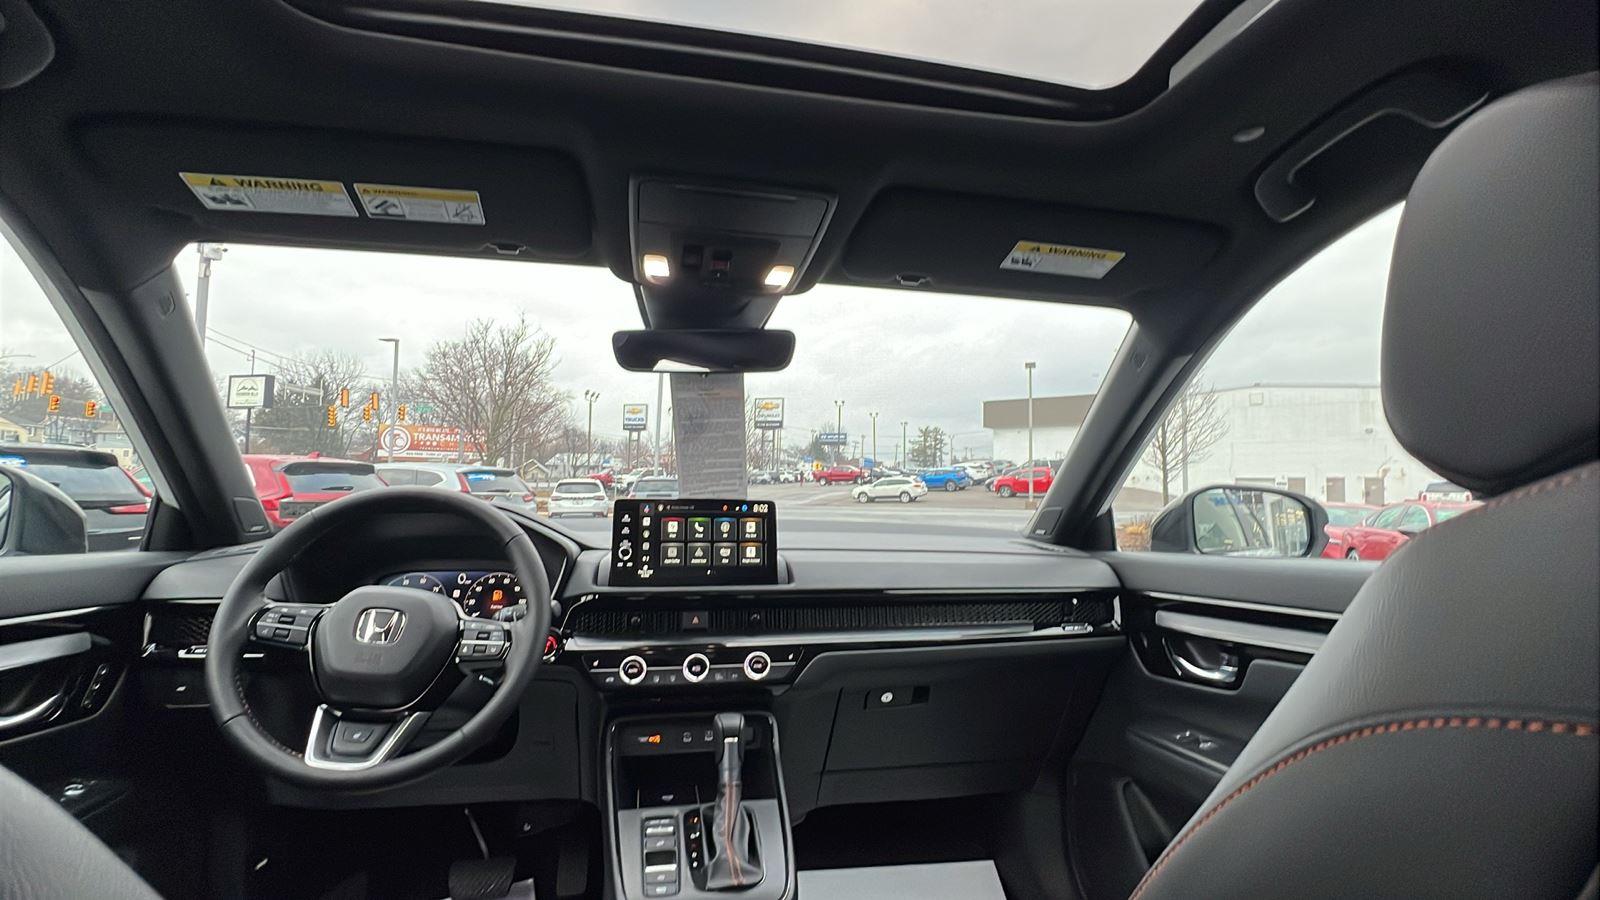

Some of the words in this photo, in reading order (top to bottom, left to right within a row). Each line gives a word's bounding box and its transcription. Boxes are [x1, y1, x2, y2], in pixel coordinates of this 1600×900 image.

[233, 177, 324, 192] WARNING
[1048, 245, 1107, 259] WARNING
[753, 503, 769, 513] 8:02
